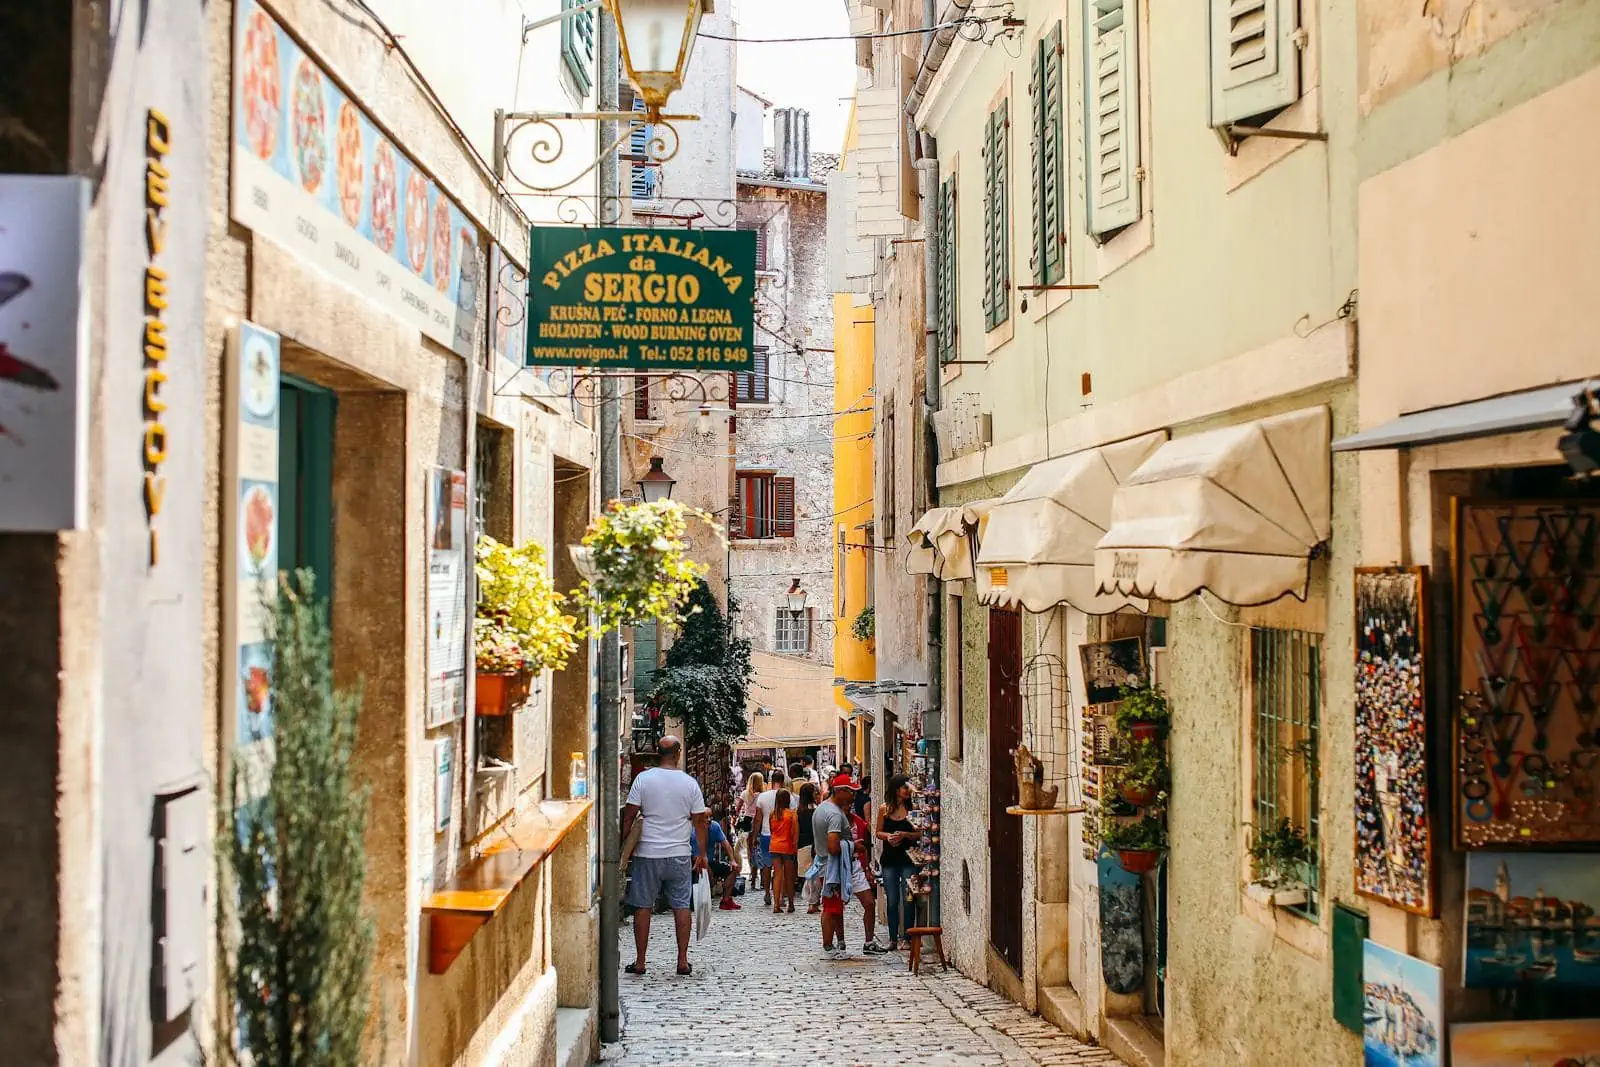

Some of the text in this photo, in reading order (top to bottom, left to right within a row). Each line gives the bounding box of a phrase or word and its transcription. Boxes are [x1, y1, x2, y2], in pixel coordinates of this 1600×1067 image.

[543, 234, 743, 294] PIZZA ITALIANA
[629, 255, 657, 272] da
[584, 272, 700, 304] SERGIO
[550, 302, 601, 321] KRUŠNA
[635, 307, 678, 323] FORNO
[679, 308, 690, 323] A
[691, 308, 733, 324] LEGNA
[144, 107, 171, 568] DEVESCOVI
[539, 323, 602, 339] HOLZOFEN
[611, 324, 649, 340] WOOD
[650, 325, 707, 341] BURNING
[709, 326, 743, 342] OVEN
[533, 344, 629, 363] www.rovigno.it
[669, 346, 694, 361] 052
[697, 347, 721, 362] 816
[723, 347, 748, 362] 949
